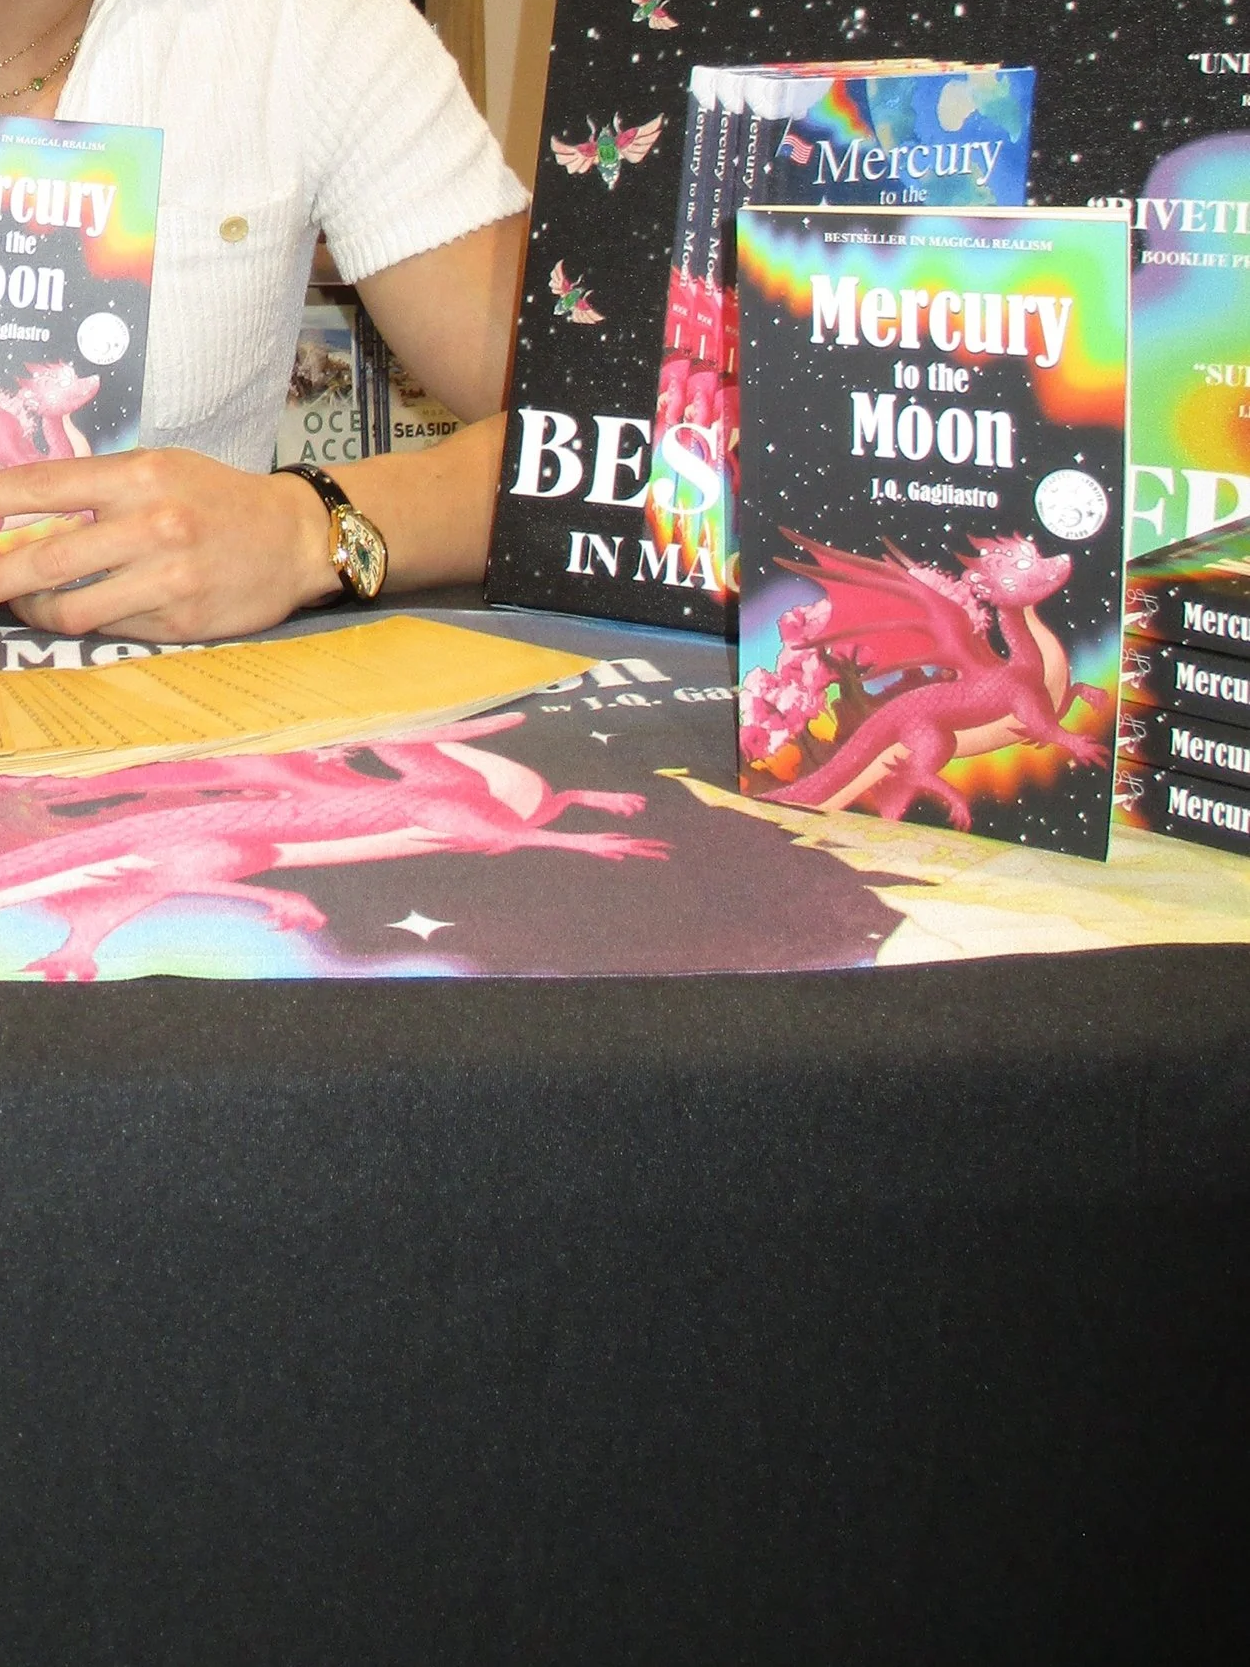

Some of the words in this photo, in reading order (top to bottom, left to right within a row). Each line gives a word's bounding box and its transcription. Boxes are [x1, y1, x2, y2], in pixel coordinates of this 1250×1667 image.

[1, 133, 15, 145] IN
[15, 135, 62, 149] MAGICAL
[62, 139, 107, 152] REALISM
[812, 138, 1004, 187] Mercury
[879, 188, 897, 206] to
[900, 185, 929, 205] the
[4, 229, 38, 256] the
[823, 230, 907, 247] BESTSELLER
[910, 234, 926, 247] IN
[928, 234, 990, 250] MAGICAL
[991, 237, 1053, 252] REALISM
[1141, 249, 1228, 269] BOOKLIFE
[808, 273, 1073, 368] Mercury
[893, 359, 920, 389] to
[927, 361, 970, 393] the
[849, 390, 1014, 469] Moon
[509, 407, 722, 515] BES
[870, 477, 904, 503] J.Q.
[907, 481, 999, 510] Gagliastro
[565, 531, 624, 578] IN
